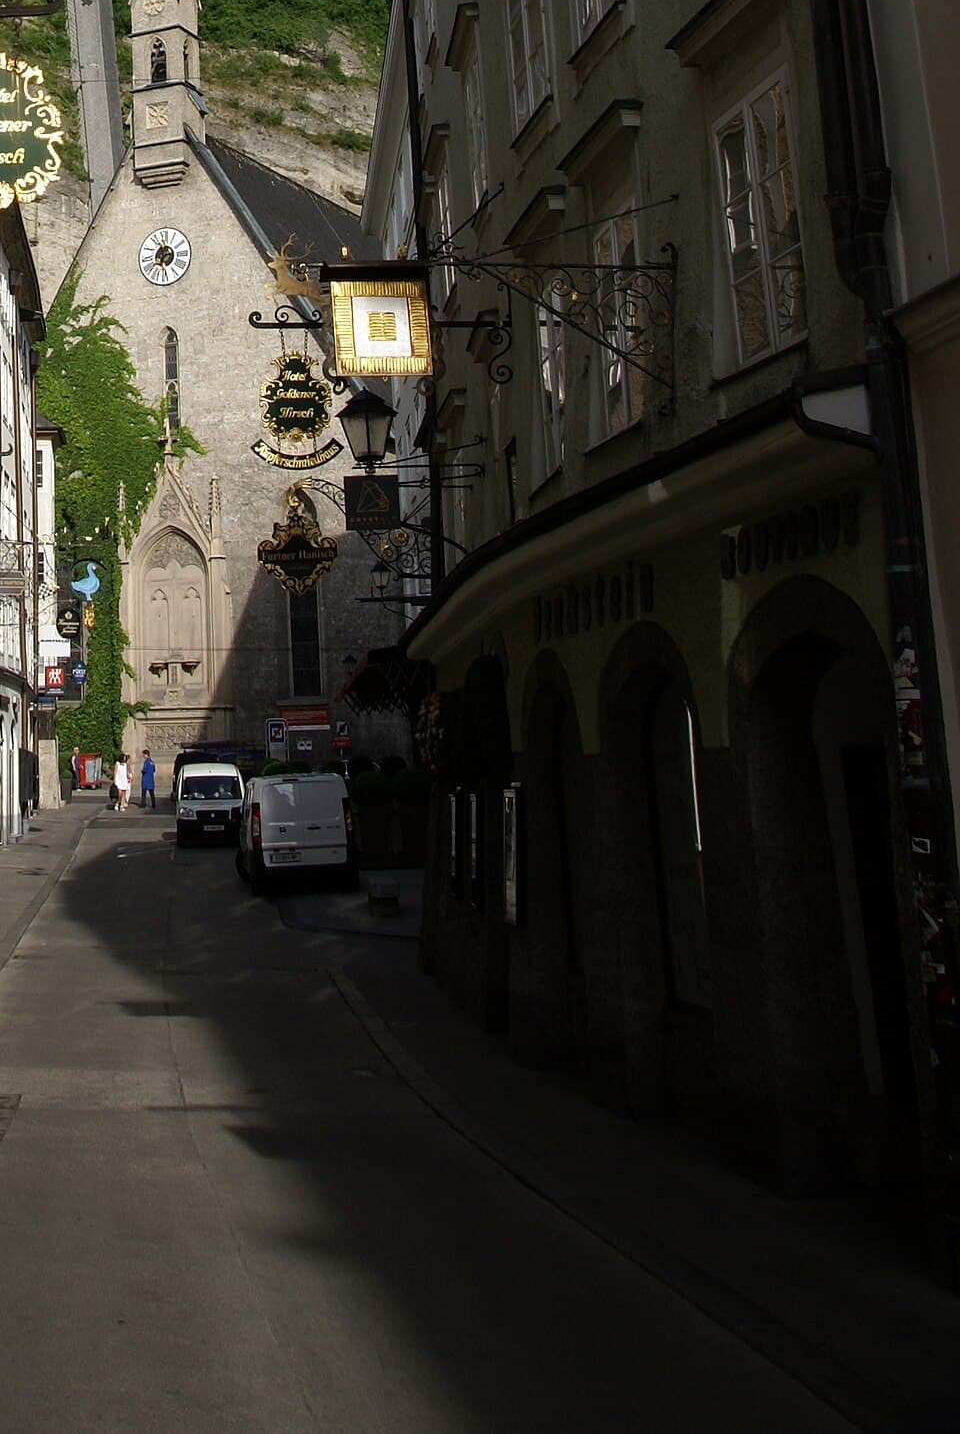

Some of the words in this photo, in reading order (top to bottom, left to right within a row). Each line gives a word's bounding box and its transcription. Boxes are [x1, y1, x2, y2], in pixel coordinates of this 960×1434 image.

[282, 370, 308, 382] Hotel
[276, 388, 317, 399] Goldener
[279, 406, 314, 418] Hirsch
